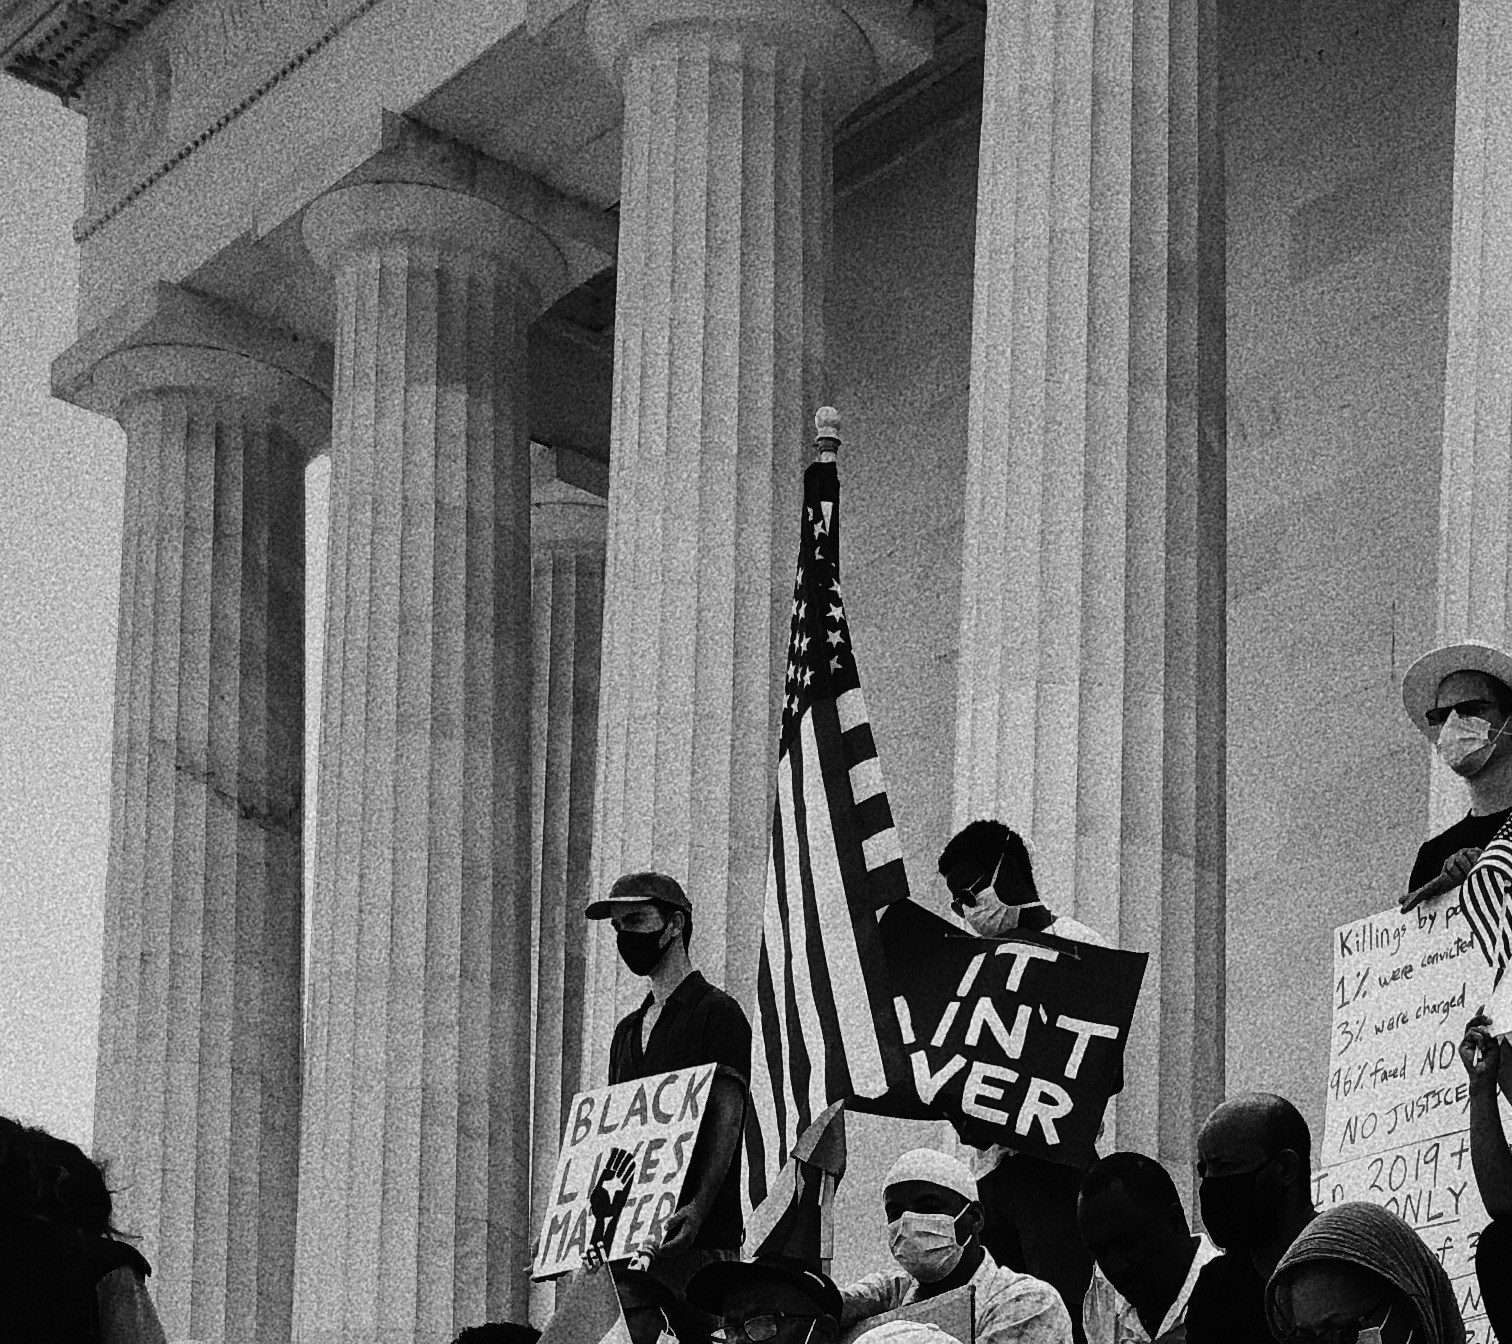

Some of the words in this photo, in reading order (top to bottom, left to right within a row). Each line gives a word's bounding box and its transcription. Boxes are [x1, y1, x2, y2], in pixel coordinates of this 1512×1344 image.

[1339, 923, 1406, 958] Killings
[1417, 906, 1437, 934] by
[1378, 964, 1414, 988] were
[1421, 931, 1475, 968] convicted
[956, 943, 1060, 997] IT
[1375, 1011, 1409, 1035] were
[1416, 982, 1466, 1025] charged
[1370, 1054, 1407, 1089] faced
[1420, 1040, 1456, 1076] NO
[570, 1069, 712, 1147] BLACK
[909, 1050, 1074, 1145] VER
[1339, 1112, 1377, 1152] NO
[557, 1131, 694, 1205] LIES
[1312, 1172, 1344, 1208] In
[1368, 1142, 1440, 1192] 2019
[540, 1191, 676, 1268] MAER
